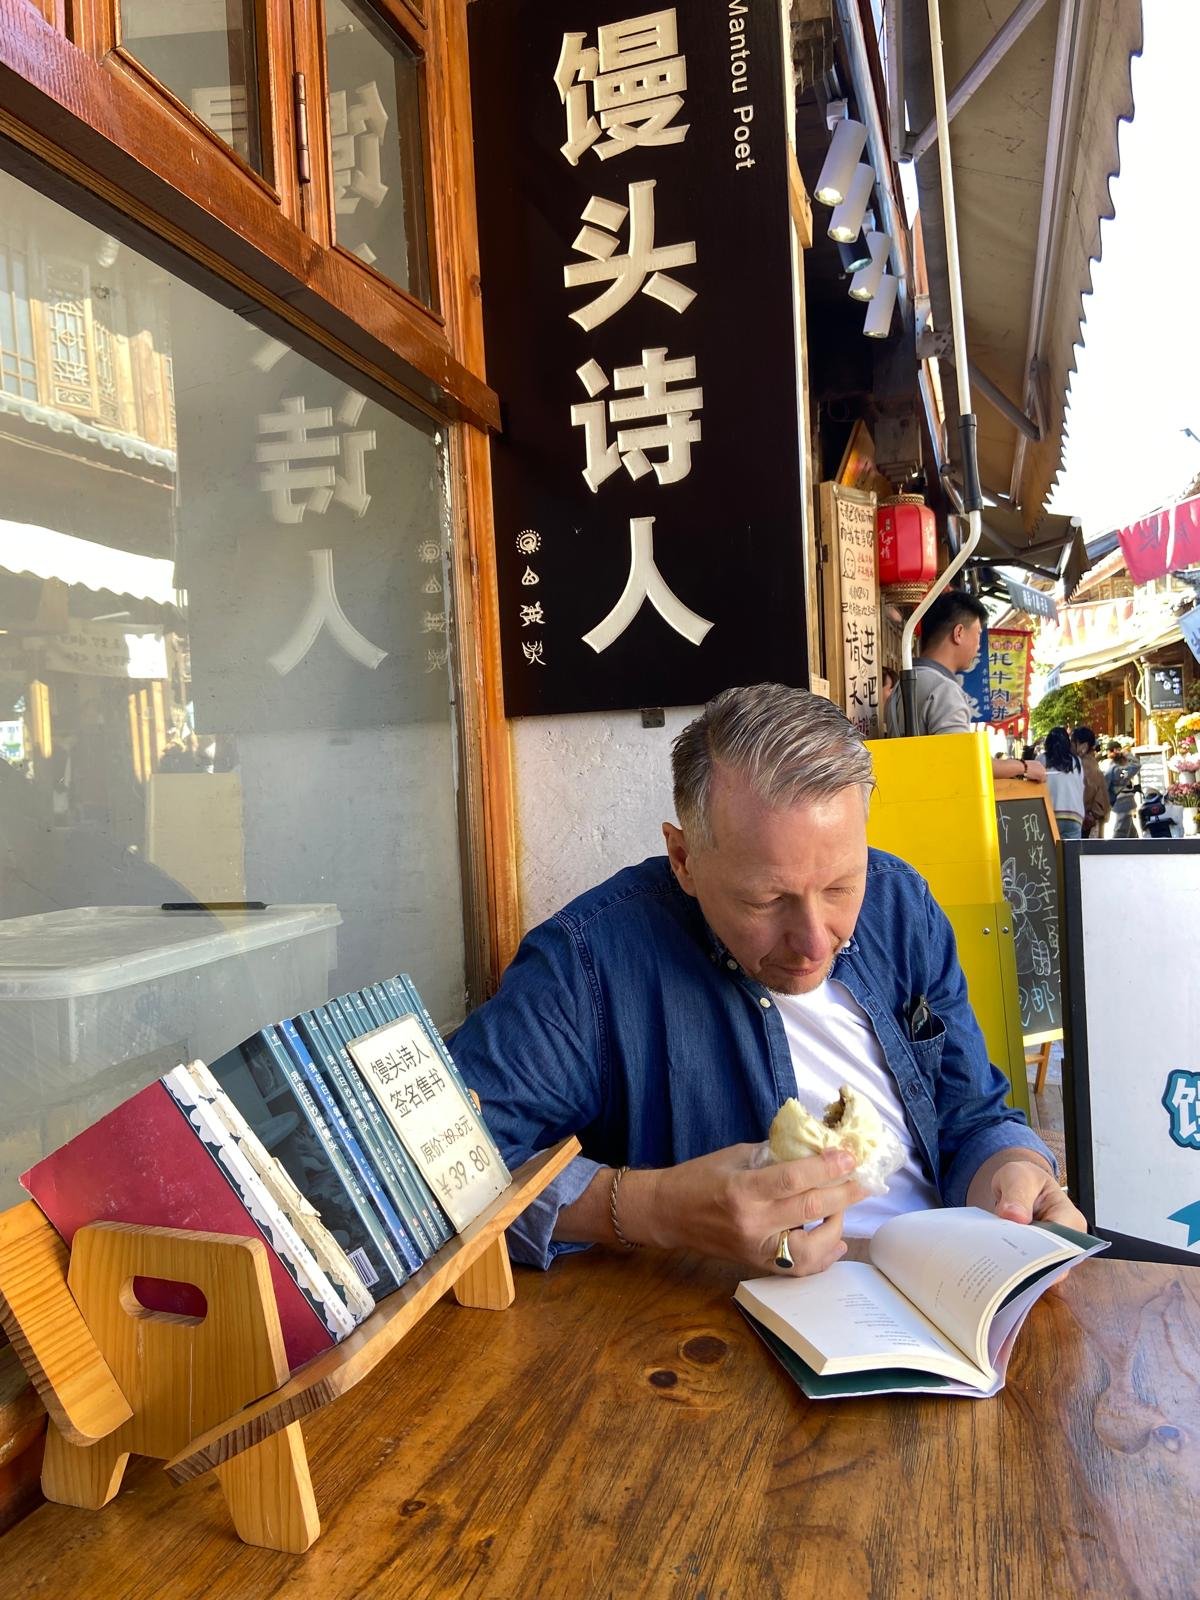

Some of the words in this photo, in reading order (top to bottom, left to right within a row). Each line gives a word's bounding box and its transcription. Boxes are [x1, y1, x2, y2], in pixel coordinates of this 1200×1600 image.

[727, 0, 750, 94] Mantou
[733, 104, 756, 172] Poet
[553, 7, 716, 654] 馒头诗人
[370, 1038, 431, 1087] 馒头诗人
[389, 1068, 447, 1119] 签名售书
